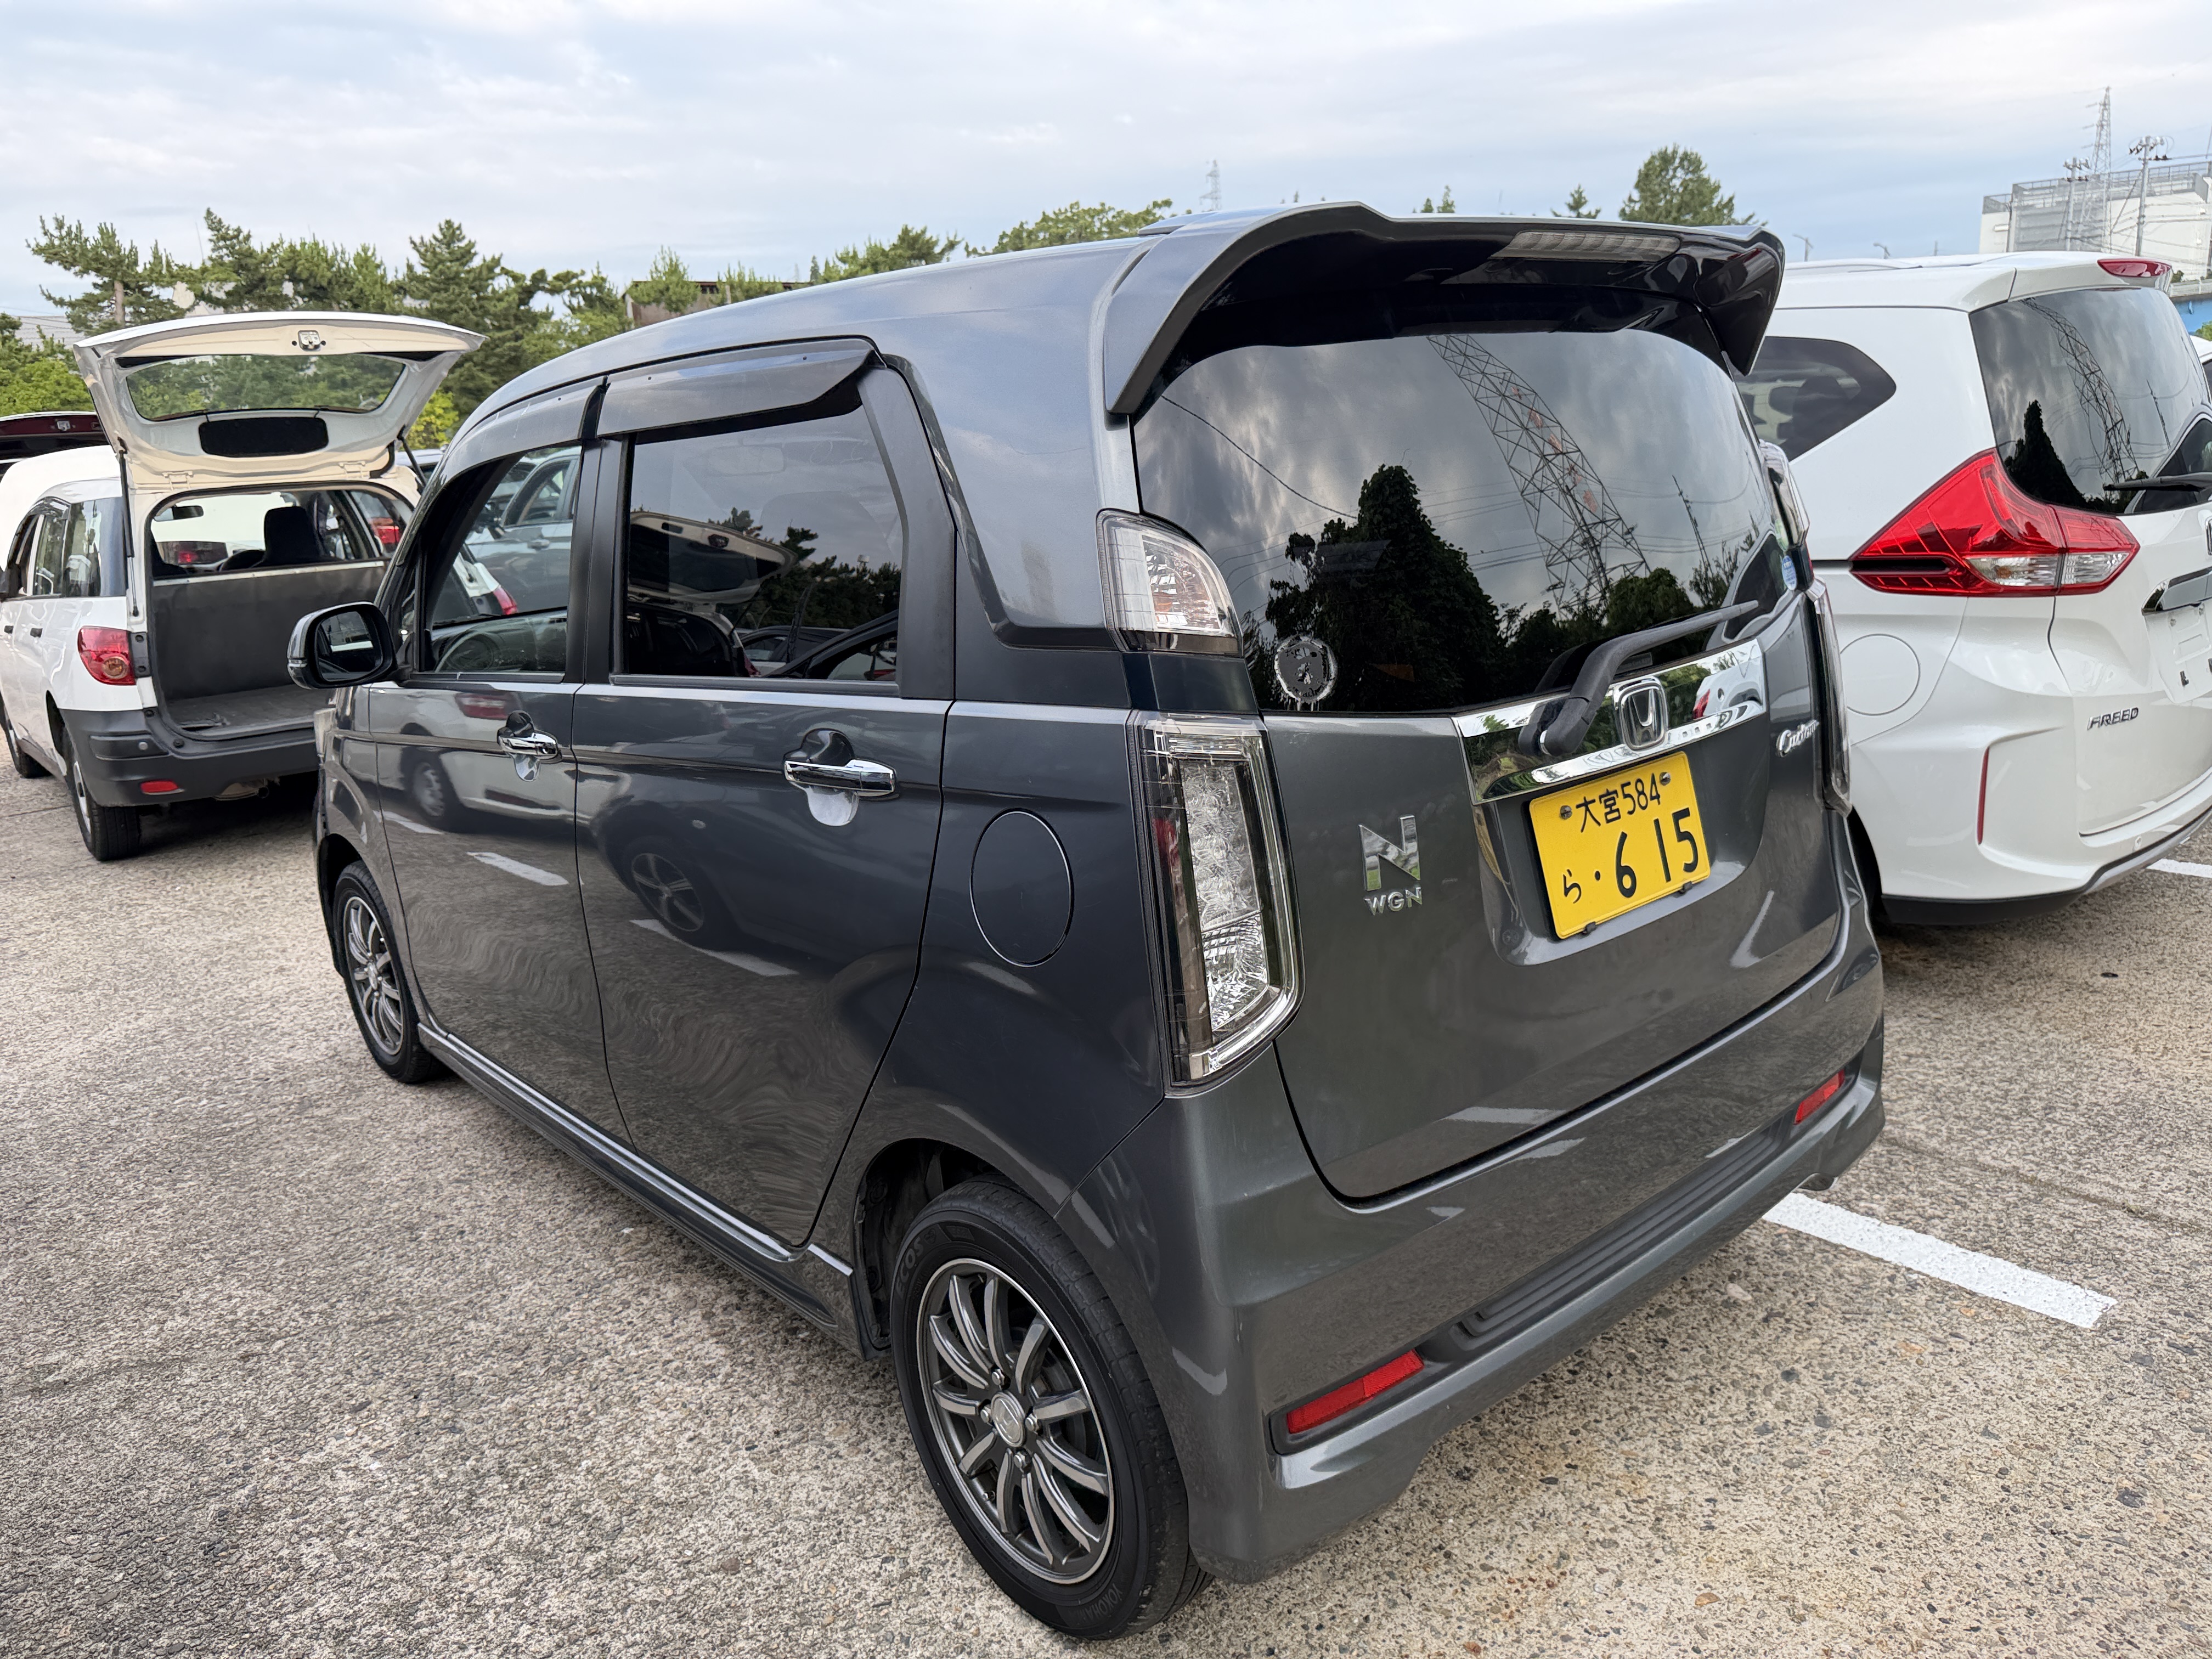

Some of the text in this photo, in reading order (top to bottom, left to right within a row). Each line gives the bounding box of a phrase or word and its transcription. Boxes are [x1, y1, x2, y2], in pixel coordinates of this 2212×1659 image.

[2087, 707, 2138, 731] FREED
[1358, 815, 1421, 891] N
[1364, 887, 1423, 916] WGN
[895, 1236, 924, 1300] ECOS
